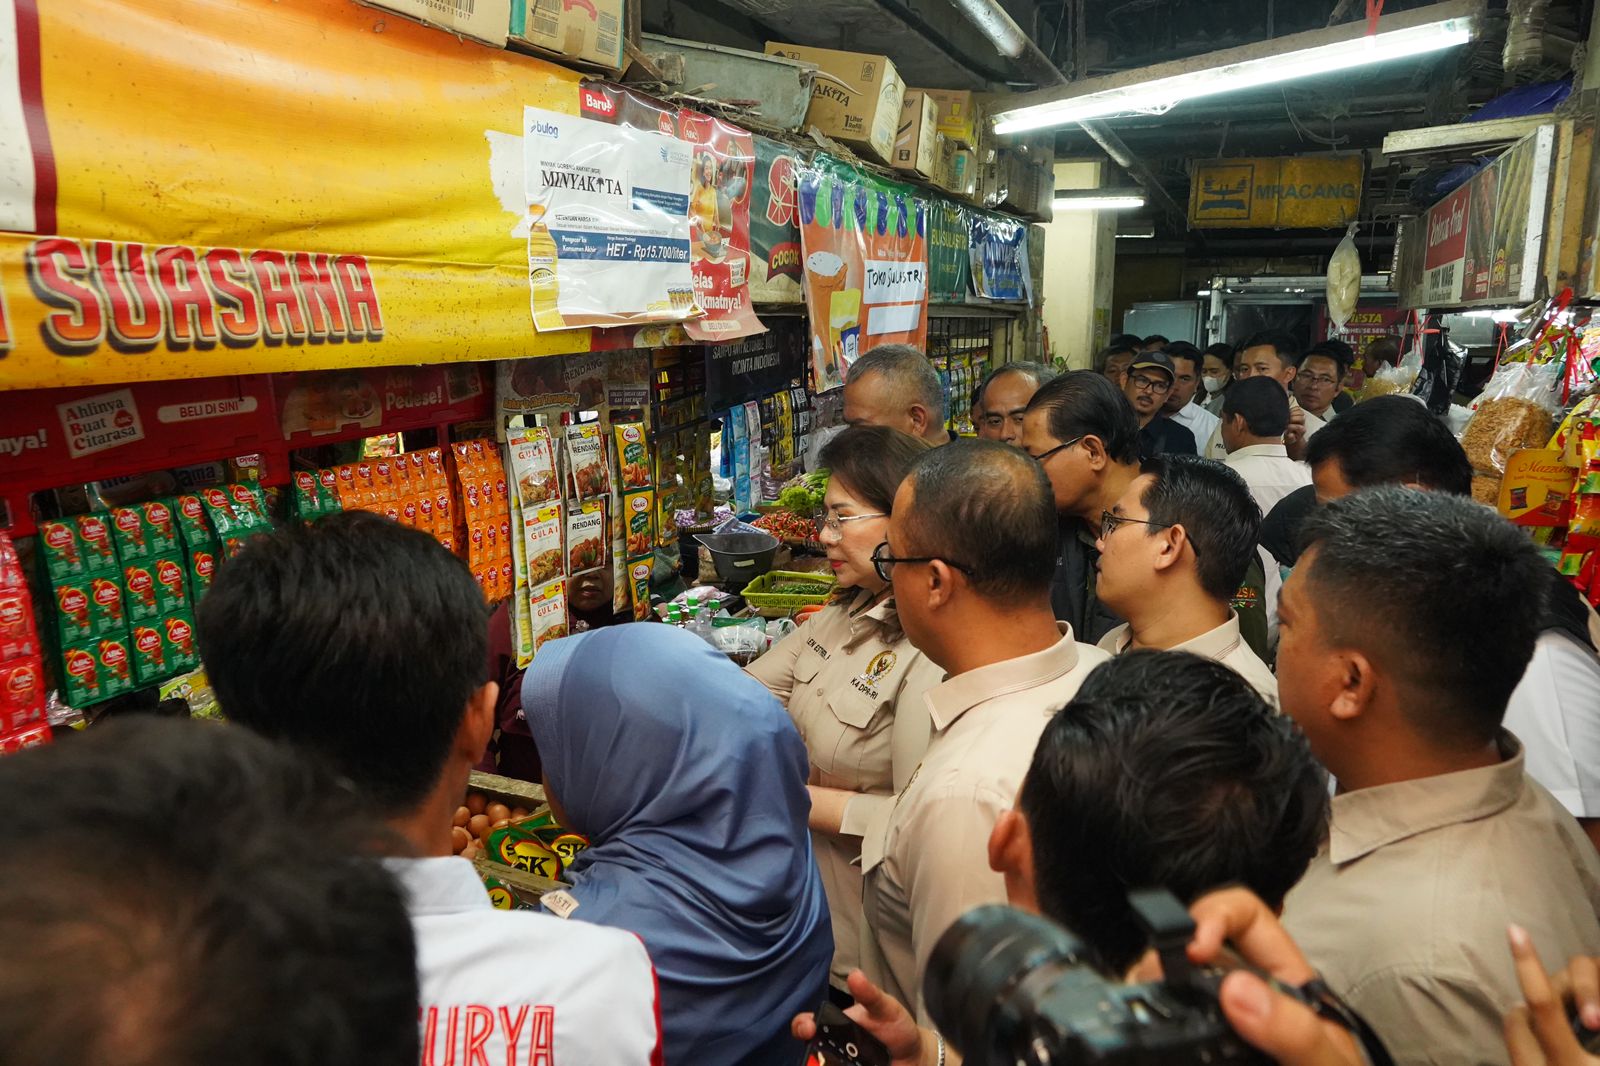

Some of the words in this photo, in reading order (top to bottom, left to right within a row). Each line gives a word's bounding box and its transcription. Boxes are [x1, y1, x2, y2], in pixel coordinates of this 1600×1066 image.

[813, 84, 850, 107] AKITA
[585, 94, 613, 115] Baru!
[536, 121, 559, 138] bulog
[606, 243, 627, 257] HET
[633, 244, 688, 260] Rp15.700/liter
[772, 250, 799, 270] COCOK
[693, 271, 713, 289] elas
[30, 238, 383, 350] SUASANA
[386, 386, 443, 411] Pedese!
[65, 398, 125, 422] Ahlinya
[179, 405, 203, 418] BELI
[205, 403, 217, 414] DI
[218, 401, 239, 413] SINI
[70, 417, 107, 437] Buat
[74, 426, 137, 451] Citarasa
[518, 447, 548, 460] GULAI
[572, 443, 600, 454] RENDANG
[212, 494, 226, 503] ABC
[238, 490, 252, 498] ABC
[186, 503, 200, 511] ABC
[120, 515, 137, 524] ABC
[151, 510, 167, 518] ABC
[85, 524, 103, 534] ABC
[572, 518, 601, 530] RENDANG
[51, 529, 70, 539] ABC
[531, 527, 559, 540] GULAI
[200, 561, 213, 570] ABC
[163, 569, 179, 577] ABC
[133, 577, 148, 585] ABC
[99, 588, 116, 598] ABC
[64, 596, 84, 605] ABC
[537, 601, 563, 617] GULAI
[172, 626, 188, 635] ABC
[141, 635, 158, 644] ABC
[106, 650, 123, 659] ABC
[73, 658, 92, 668] ABC
[858, 683, 878, 700] DPR-RI
[505, 843, 516, 857] S
[418, 1004, 555, 1066] URYA
